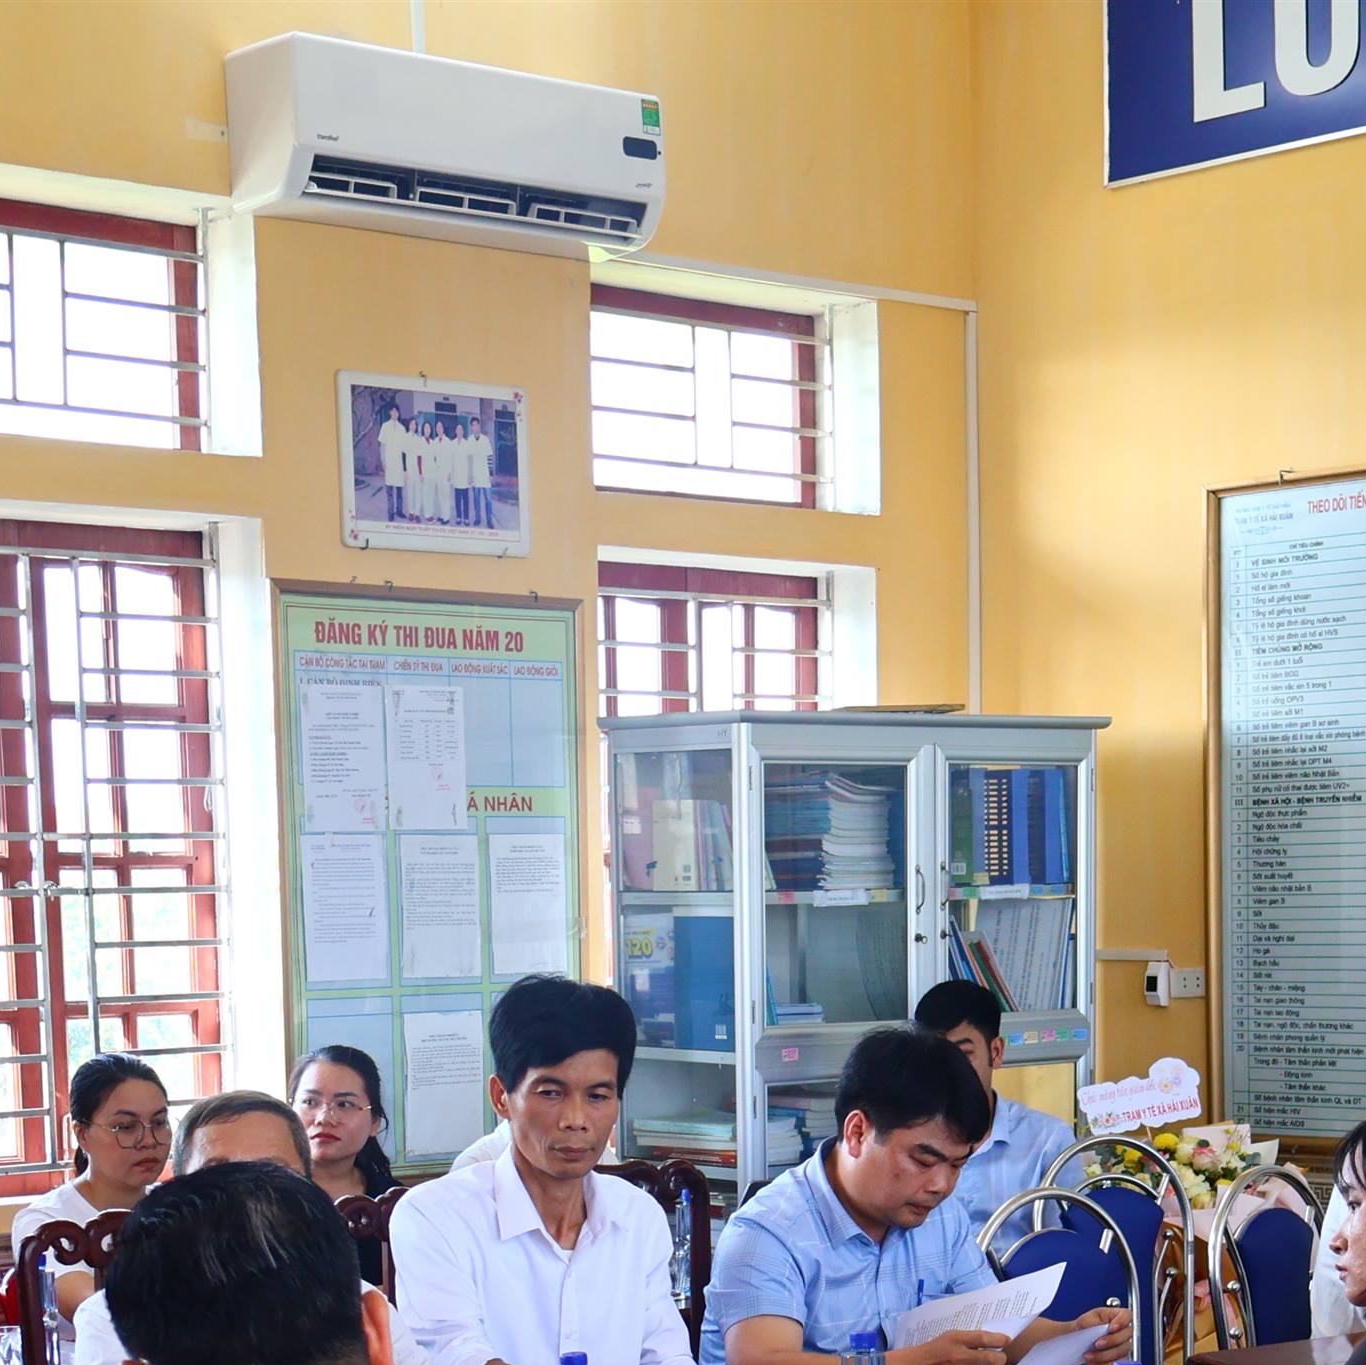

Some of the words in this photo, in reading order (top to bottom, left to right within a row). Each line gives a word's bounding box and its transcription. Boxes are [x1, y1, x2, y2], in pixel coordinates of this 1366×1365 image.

[1307, 499, 1330, 514] THEO
[1332, 493, 1347, 511] DÕI
[314, 617, 362, 645] ĐĂNG
[368, 619, 388, 646] KÝ
[393, 625, 419, 648] THI
[424, 627, 457, 649] ĐUA
[462, 624, 499, 651] NĂM
[504, 631, 524, 653] 20
[466, 792, 479, 812] Á
[485, 792, 533, 812] NHÂN
